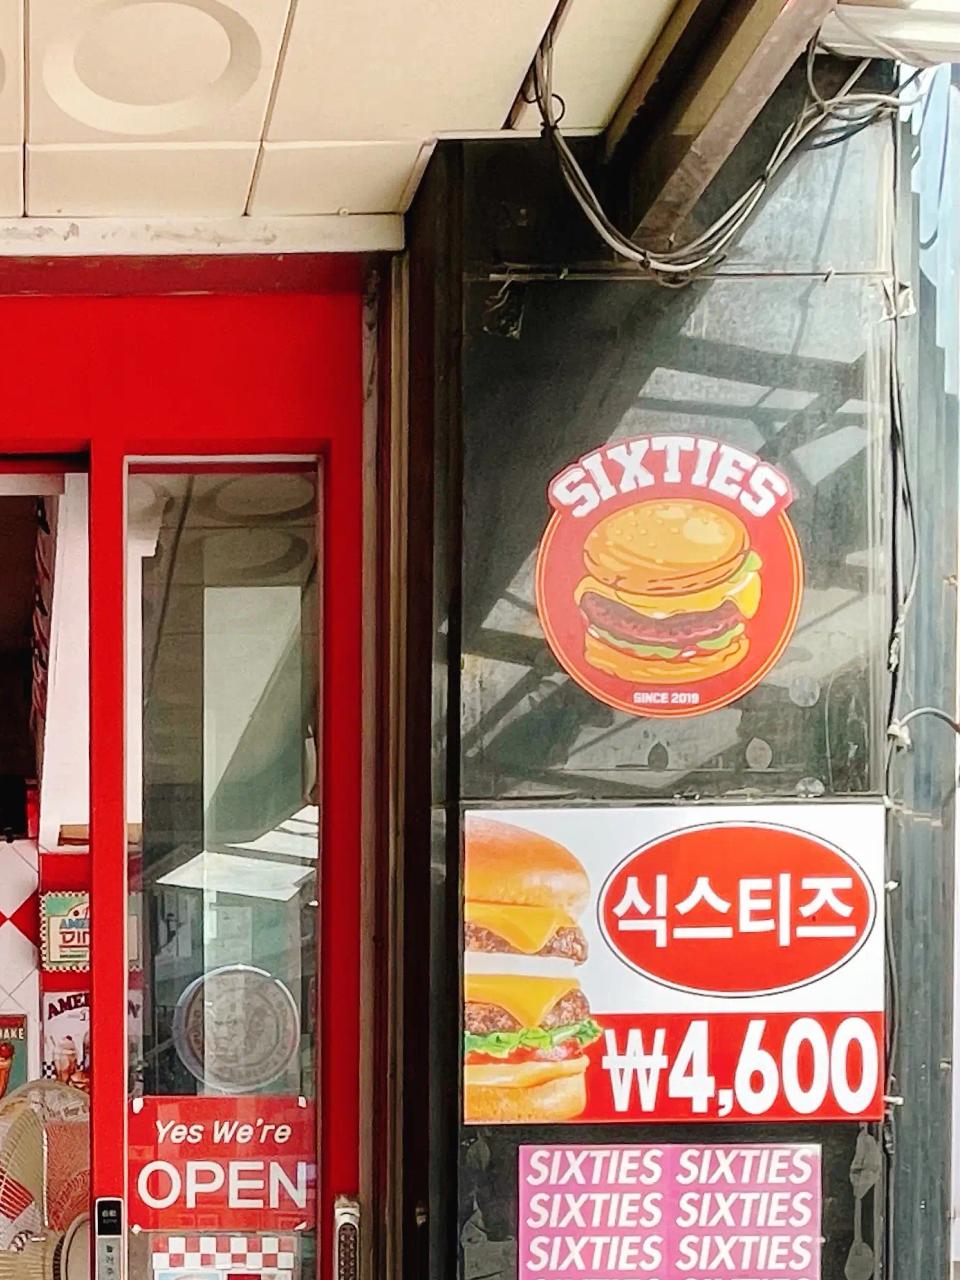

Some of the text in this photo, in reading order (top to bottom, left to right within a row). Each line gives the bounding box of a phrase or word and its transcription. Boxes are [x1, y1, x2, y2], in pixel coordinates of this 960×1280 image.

[552, 436, 788, 517] SIXTIES
[634, 693, 699, 704] SINCE 2019
[613, 873, 856, 947] 식스티즈
[156, 1119, 291, 1143] Yes We're
[138, 1161, 306, 1208] OPEN
[527, 1147, 813, 1185] SIXTIES SIXTIES
[527, 1192, 812, 1228] SIXTIES SIXTIES
[527, 1235, 813, 1270] SIXTIES SIXTIES
